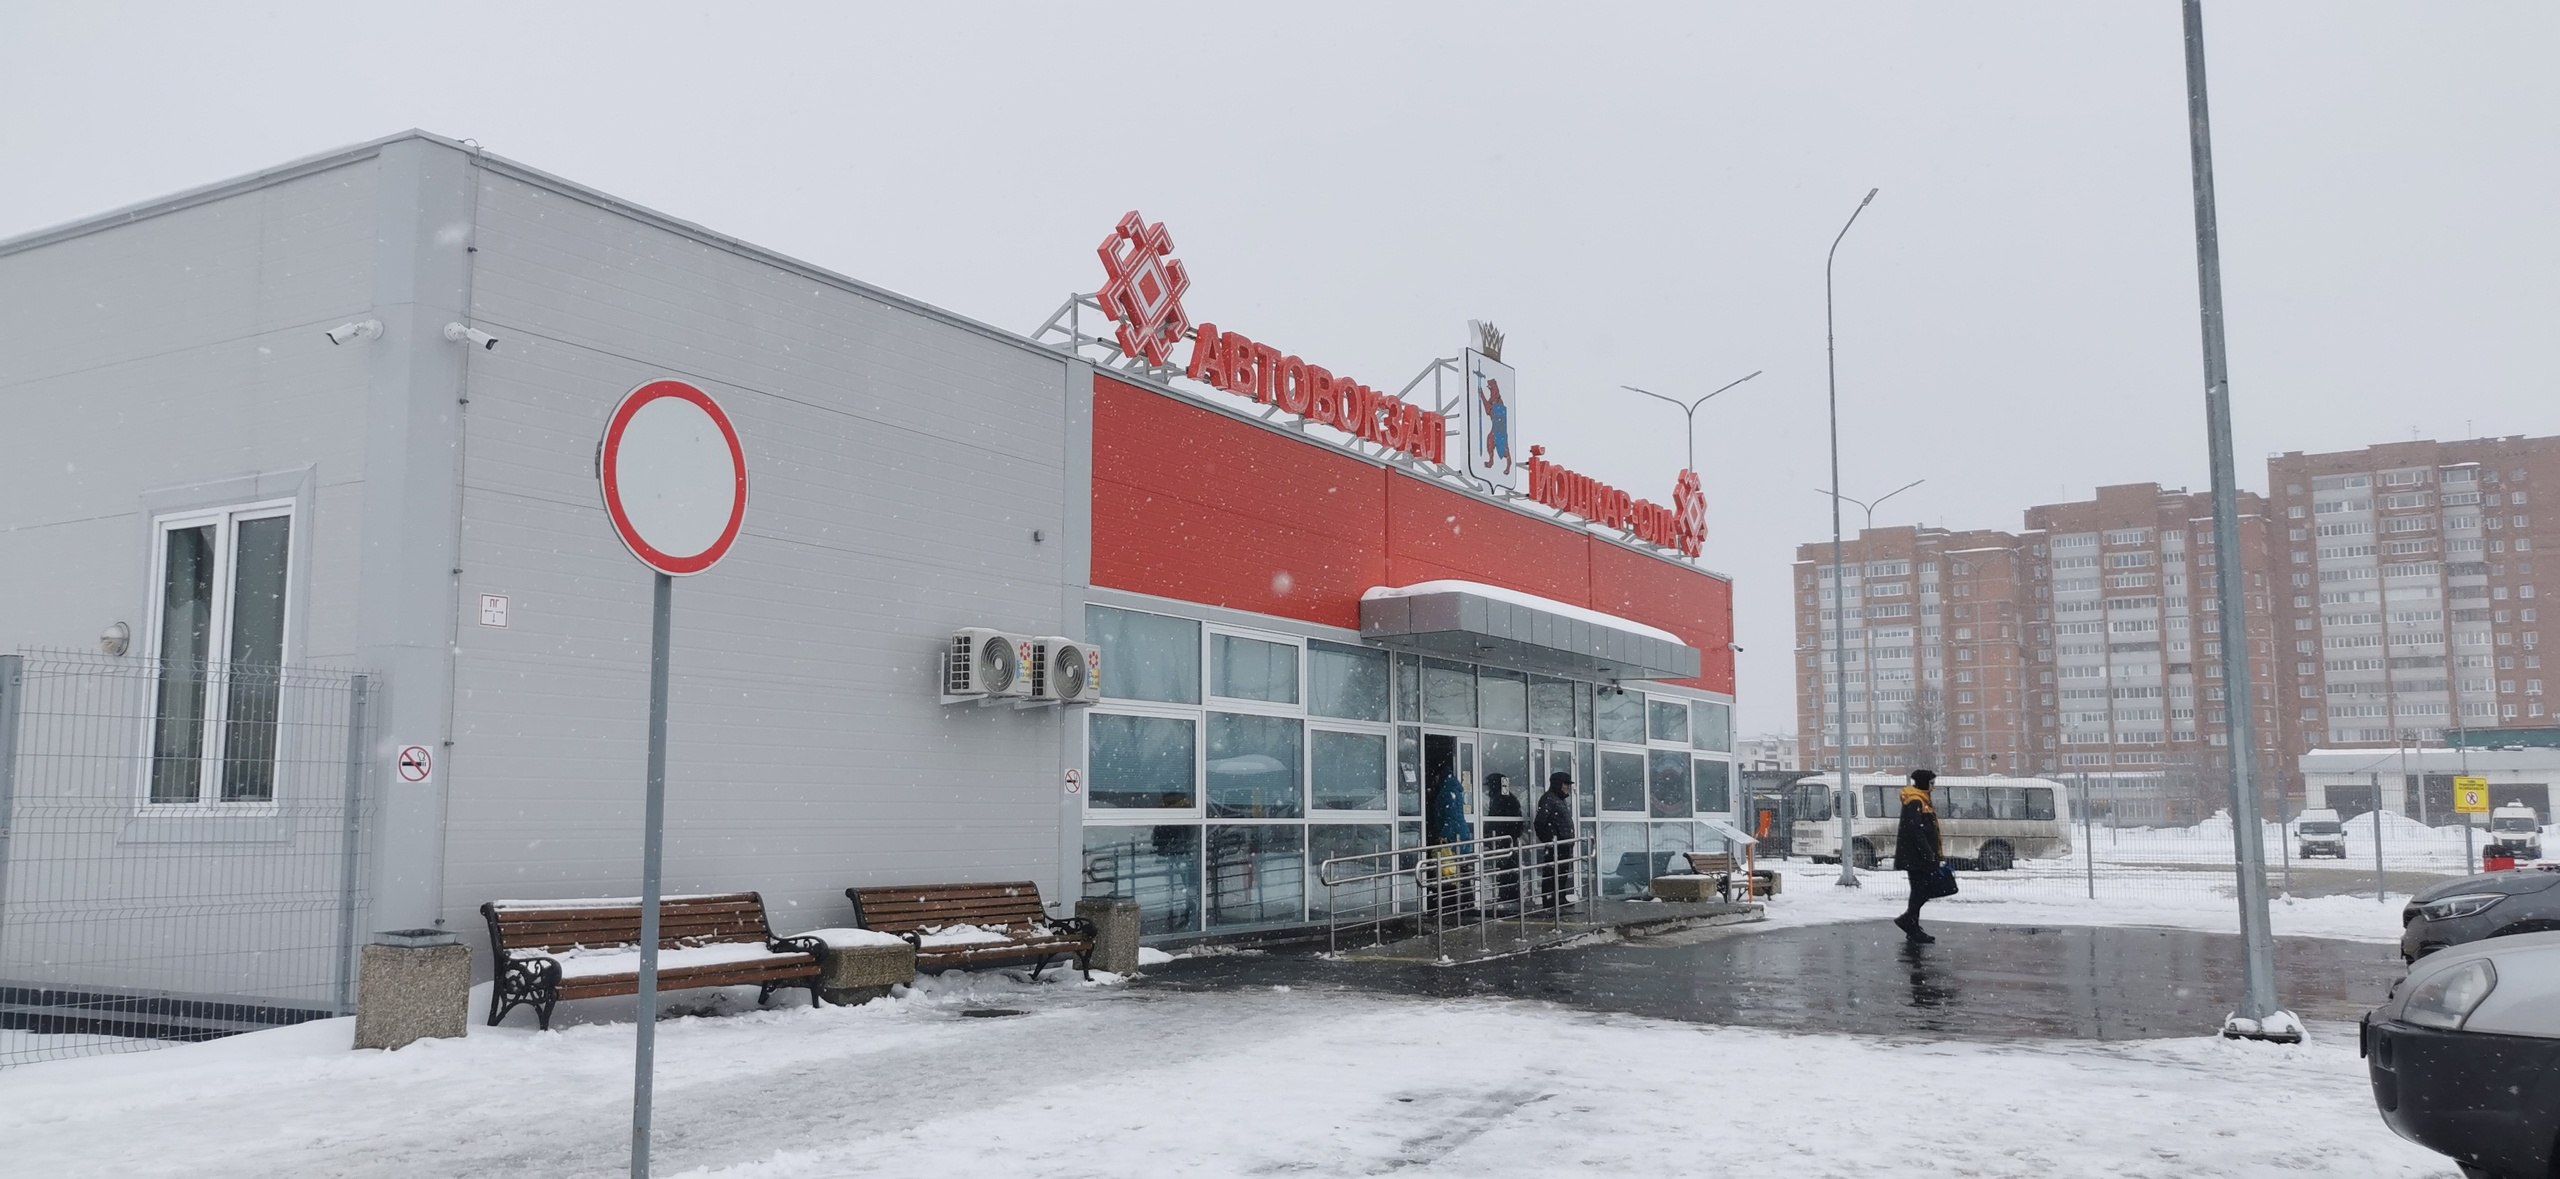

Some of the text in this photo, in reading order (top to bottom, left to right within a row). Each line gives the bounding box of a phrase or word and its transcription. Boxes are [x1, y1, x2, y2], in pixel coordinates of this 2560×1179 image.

[1187, 322, 1446, 464] АВТОВОКЗАЛ
[1528, 444, 1680, 549] ЙОШКАР-ОЛА
[489, 598, 500, 608] ПГ
